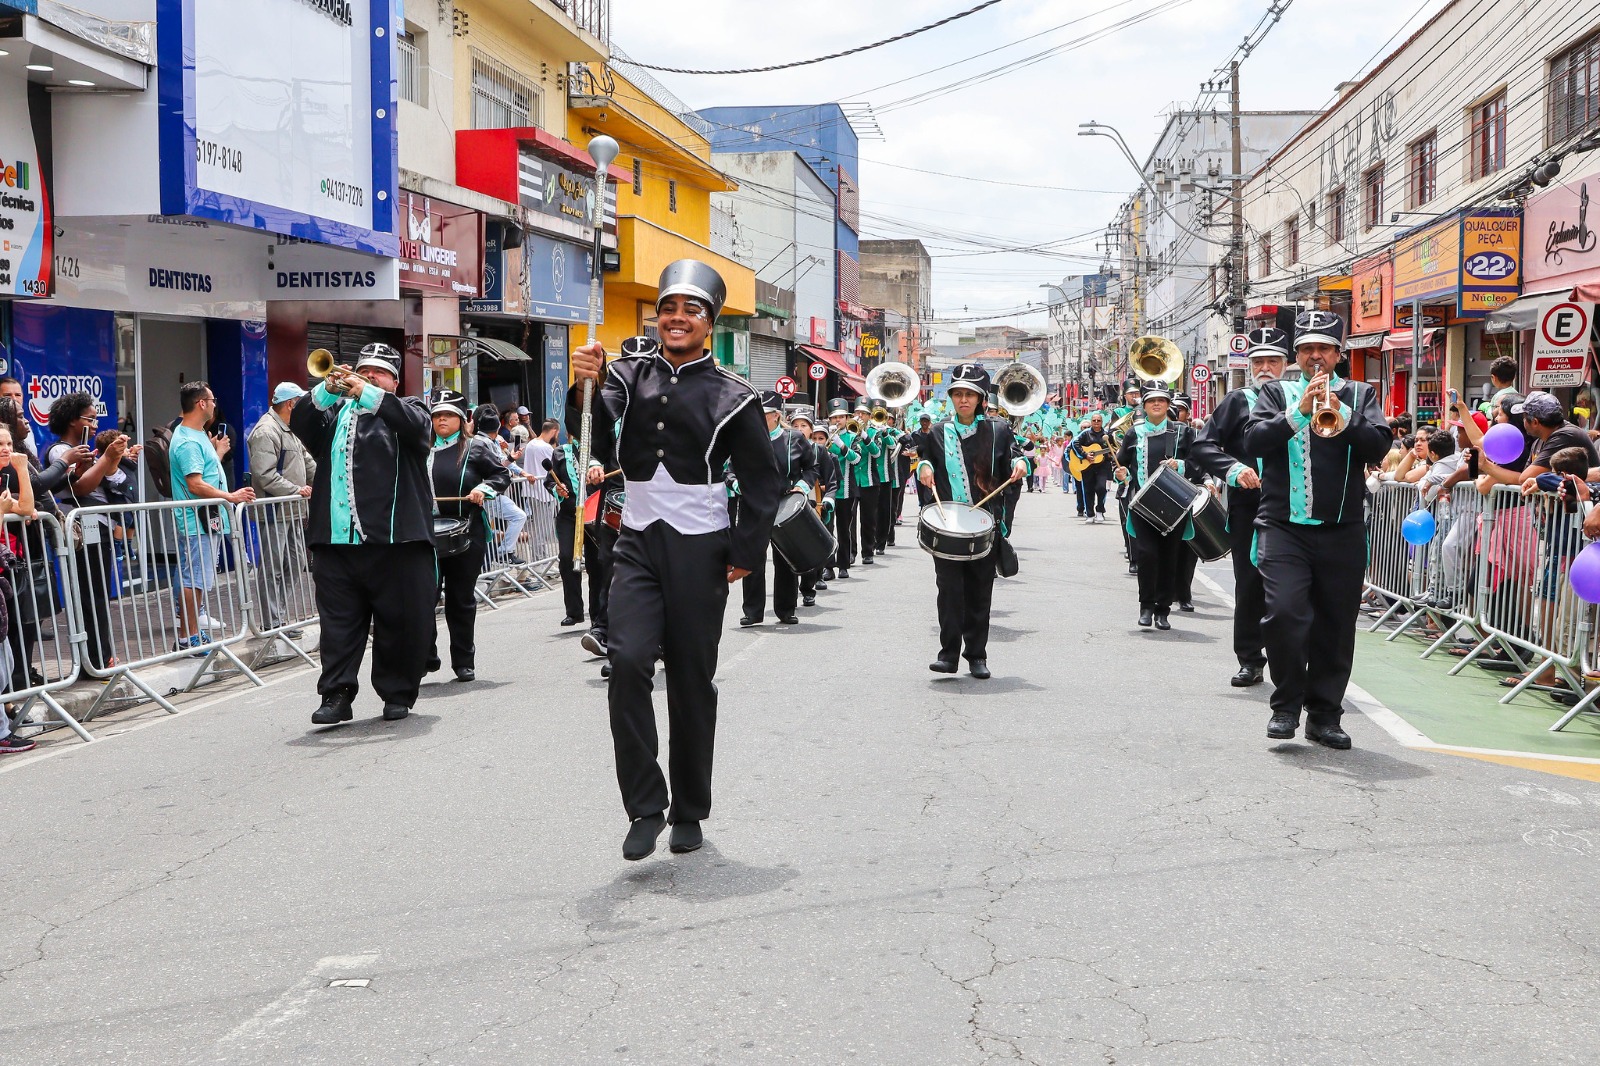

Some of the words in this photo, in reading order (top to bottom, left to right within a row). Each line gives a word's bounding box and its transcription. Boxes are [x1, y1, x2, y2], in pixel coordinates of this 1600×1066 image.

[326, 178, 363, 207] 94137-7278
[1464, 221, 1518, 232] QUALQUER
[1478, 233, 1503, 247] PEÇA
[421, 244, 457, 267] LINGERIE
[55, 255, 80, 278] 1426
[22, 279, 46, 295] 1430
[149, 267, 212, 293] DENTISTAS
[276, 271, 376, 288] DENTISTAS
[1471, 293, 1508, 302] Núcleo
[1555, 312, 1574, 338] E
[860, 333, 879, 346] Tam
[1235, 338, 1243, 351] E
[812, 366, 824, 374] 30
[1194, 369, 1208, 378] 30
[41, 378, 101, 398] SORRISO
